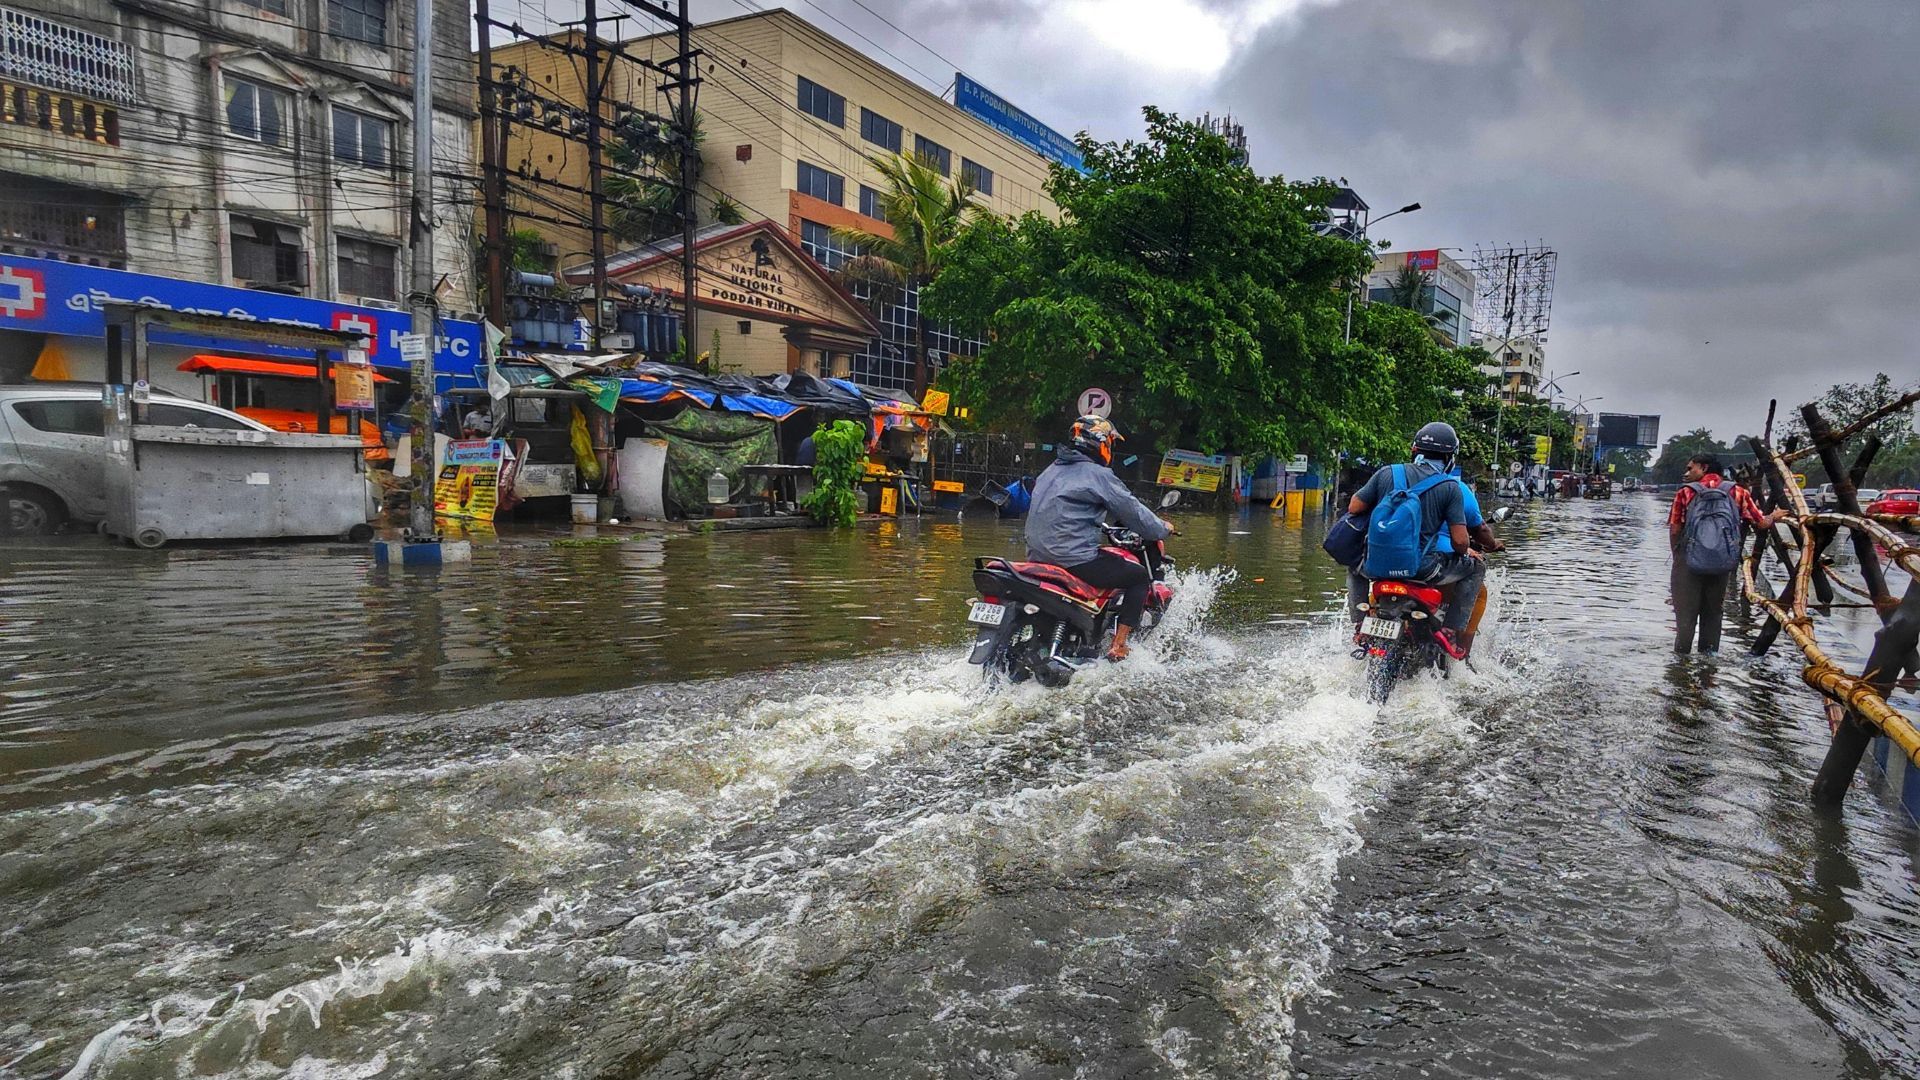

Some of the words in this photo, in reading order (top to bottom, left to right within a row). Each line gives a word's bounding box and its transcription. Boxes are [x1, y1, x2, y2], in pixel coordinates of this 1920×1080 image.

[964, 81, 972, 94] B.
[973, 87, 979, 98] P.
[980, 90, 1007, 115] PODDAR
[1007, 105, 1039, 134] INSTITUTE
[1040, 124, 1048, 138] OF
[731, 263, 783, 284] NATURAL
[731, 275, 784, 295] HEIGHTS
[712, 288, 762, 307] PODDAR
[767, 298, 800, 315] VIHAR
[390, 329, 470, 357] HFC
[1389, 569, 1409, 577] NIKE
[977, 604, 987, 612] WB
